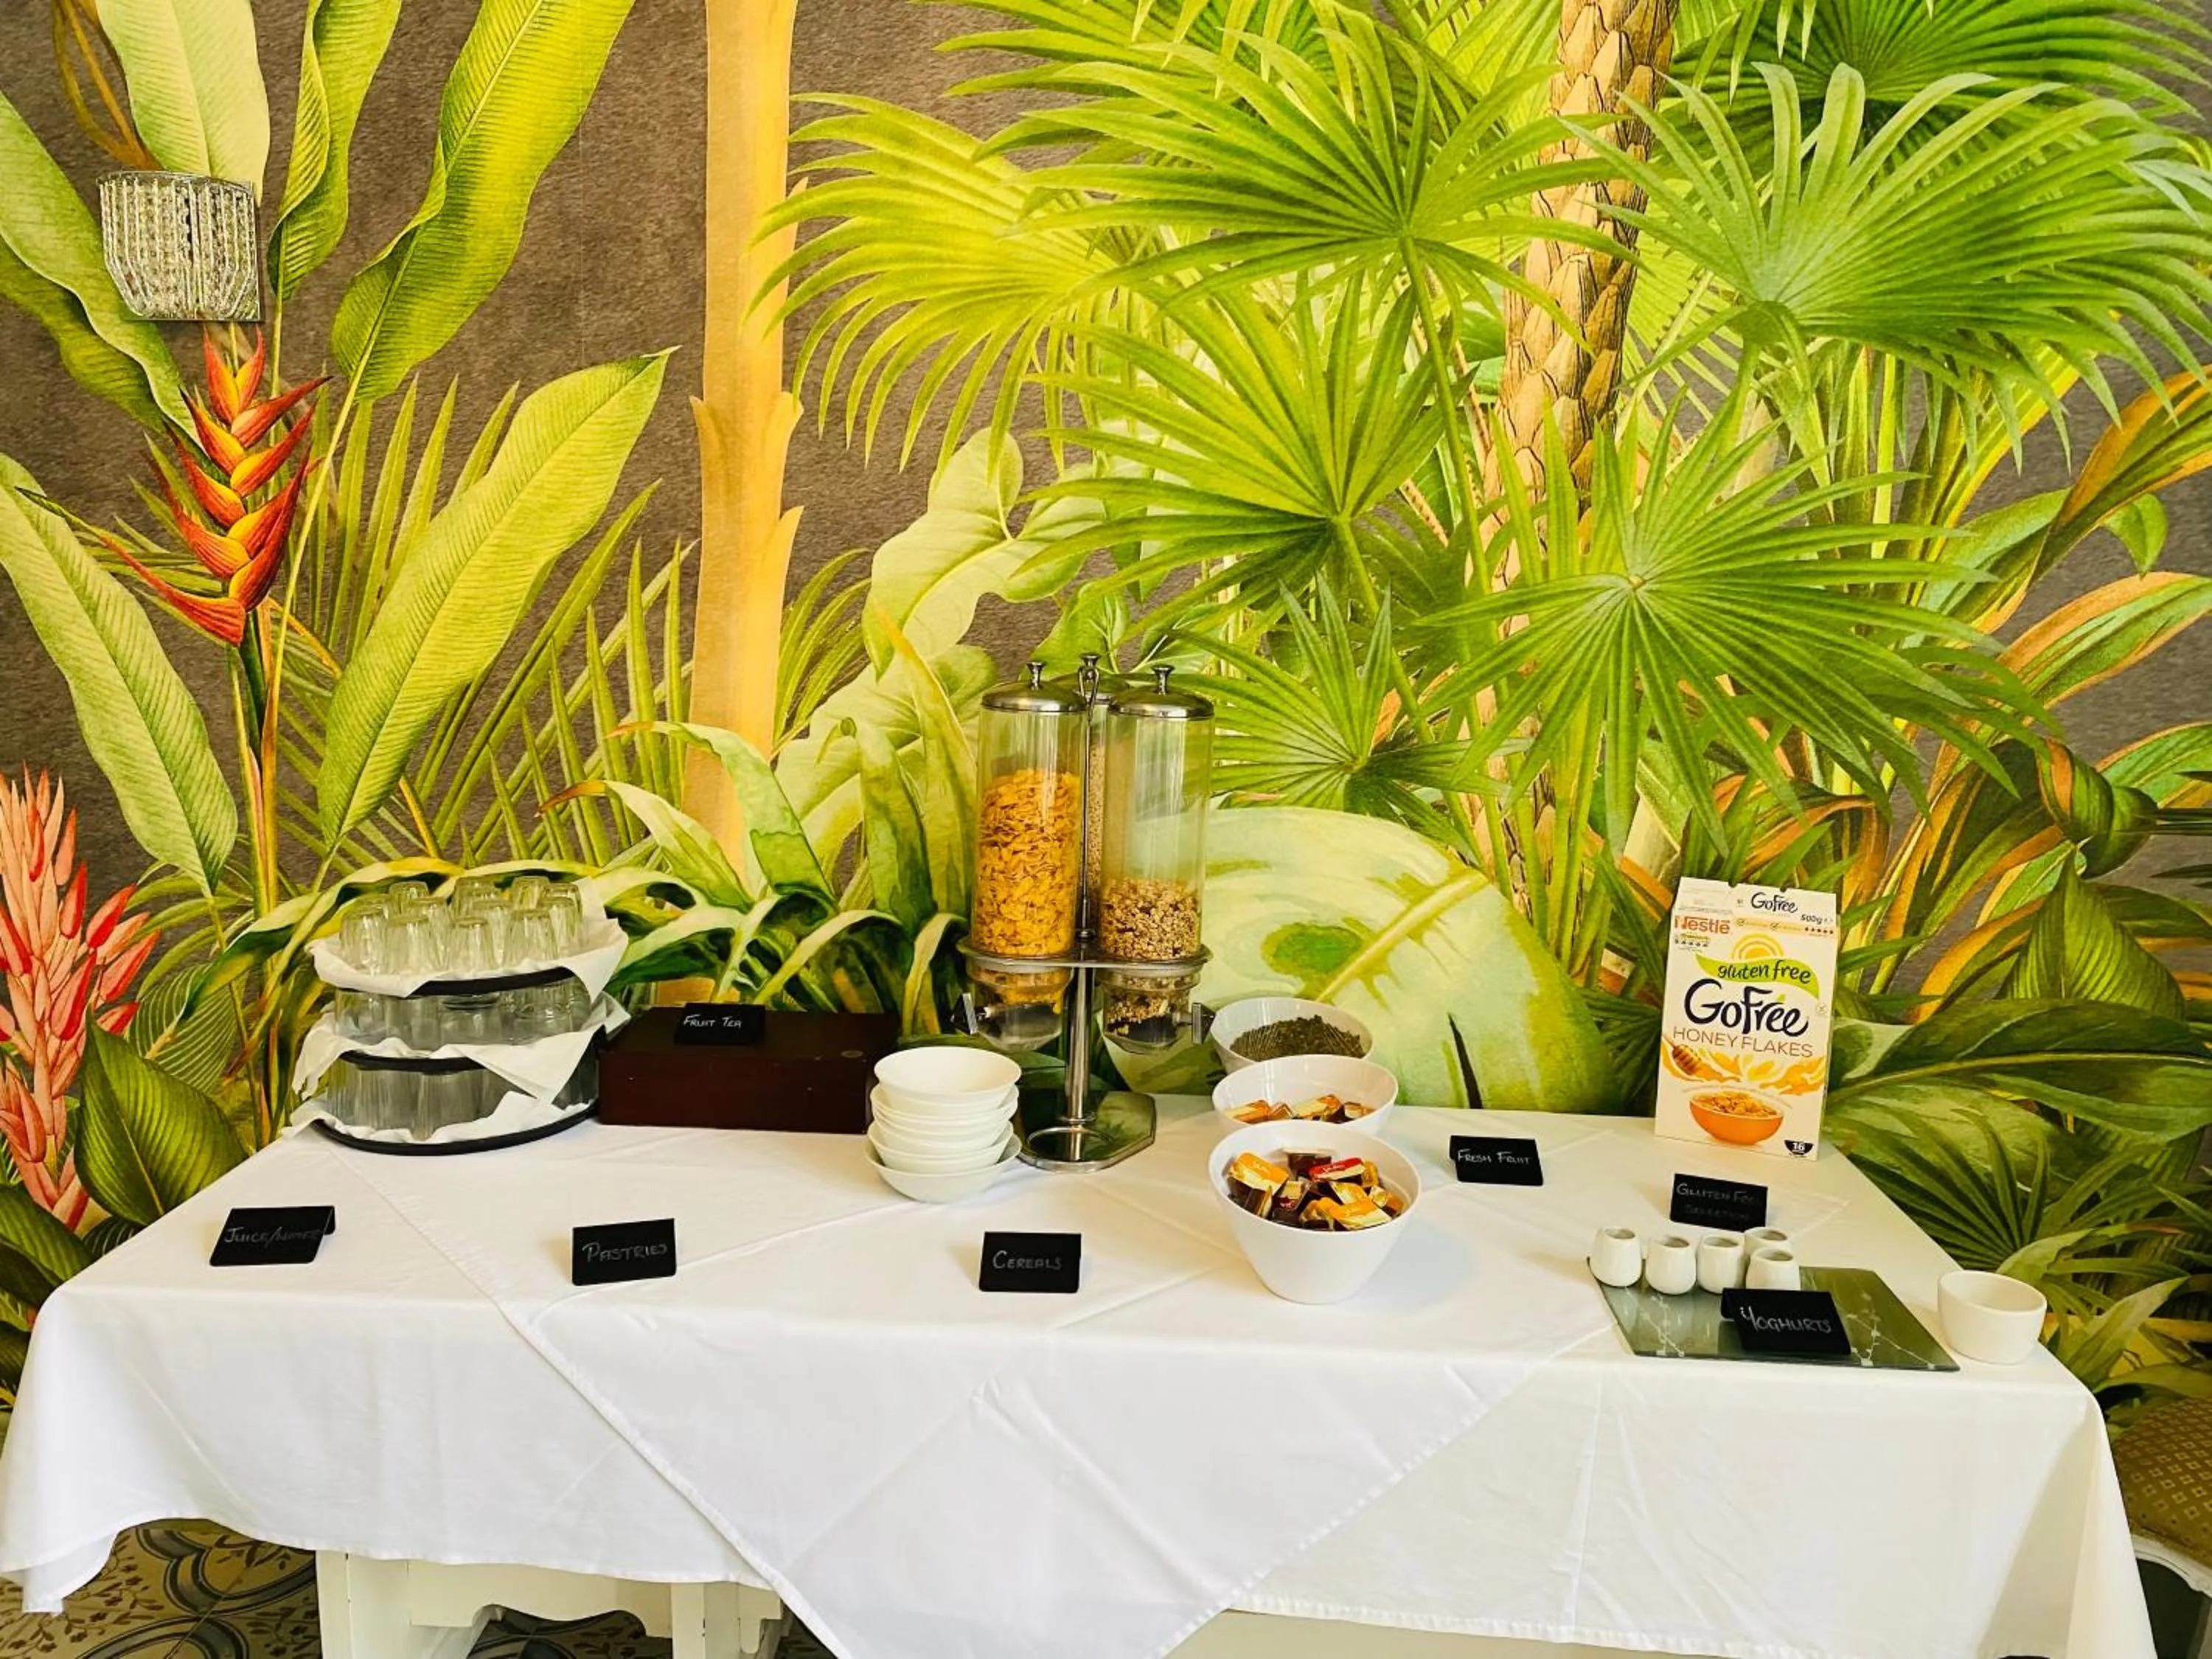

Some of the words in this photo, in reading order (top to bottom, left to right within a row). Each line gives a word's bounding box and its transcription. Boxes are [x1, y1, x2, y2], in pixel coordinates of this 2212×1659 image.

[1750, 891, 1798, 914] GoFree
[1800, 914, 1823, 925] 500g
[1717, 963, 1769, 979] gluten
[1773, 959, 1812, 984] free
[1683, 978, 1809, 1037] GoFree
[1673, 1026, 1738, 1048] HONEY
[1740, 1036, 1814, 1058] FLAKES
